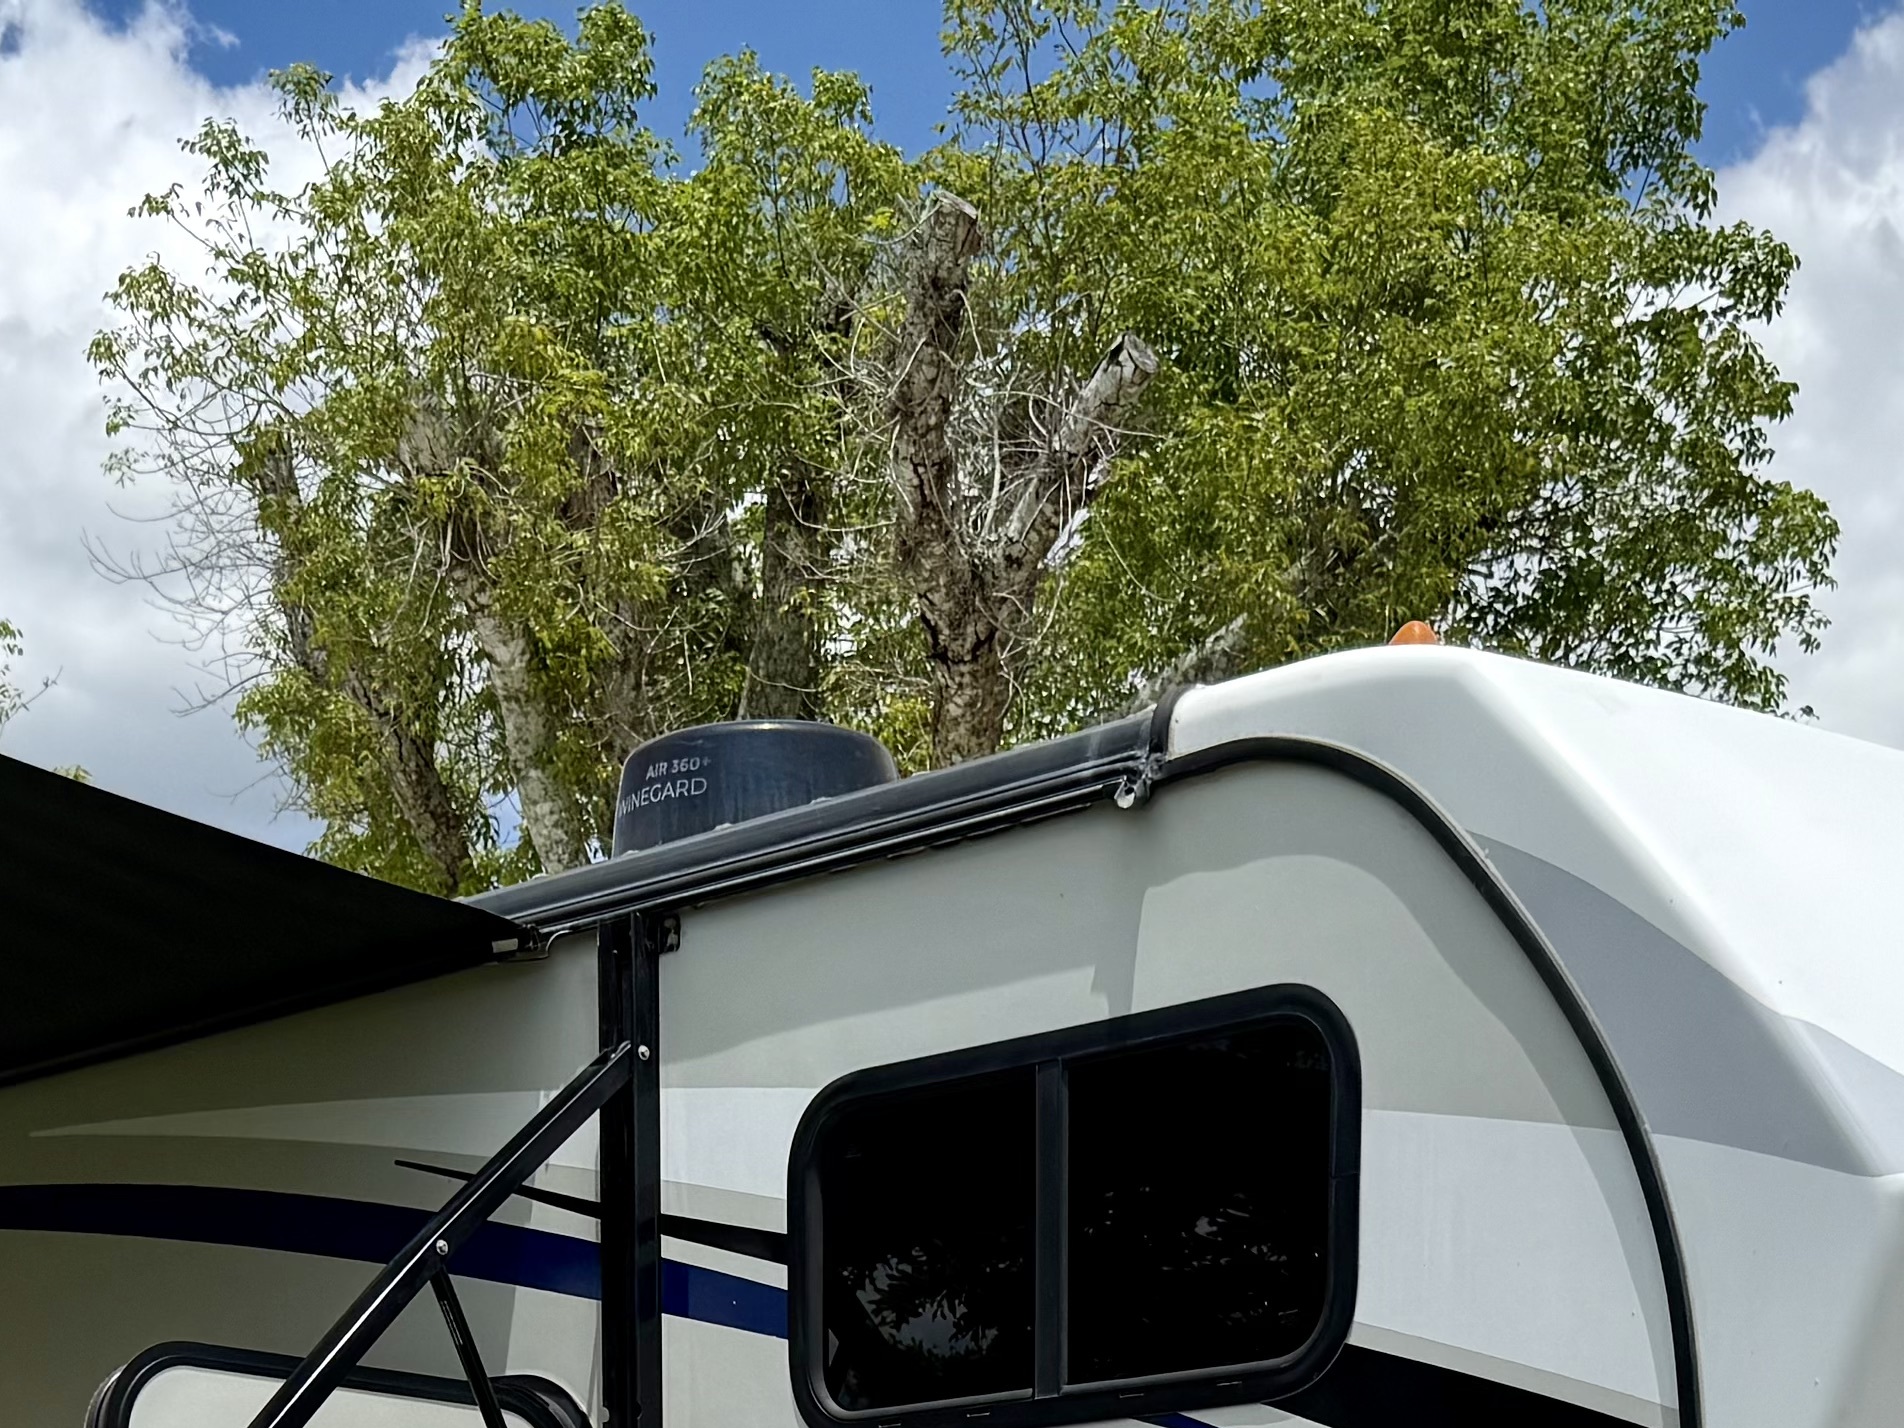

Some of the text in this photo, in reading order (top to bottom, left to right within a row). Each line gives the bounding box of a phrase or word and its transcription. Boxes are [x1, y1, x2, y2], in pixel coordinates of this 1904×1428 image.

[645, 756, 712, 781] AIR 360+
[618, 778, 707, 818] WINEGARD
